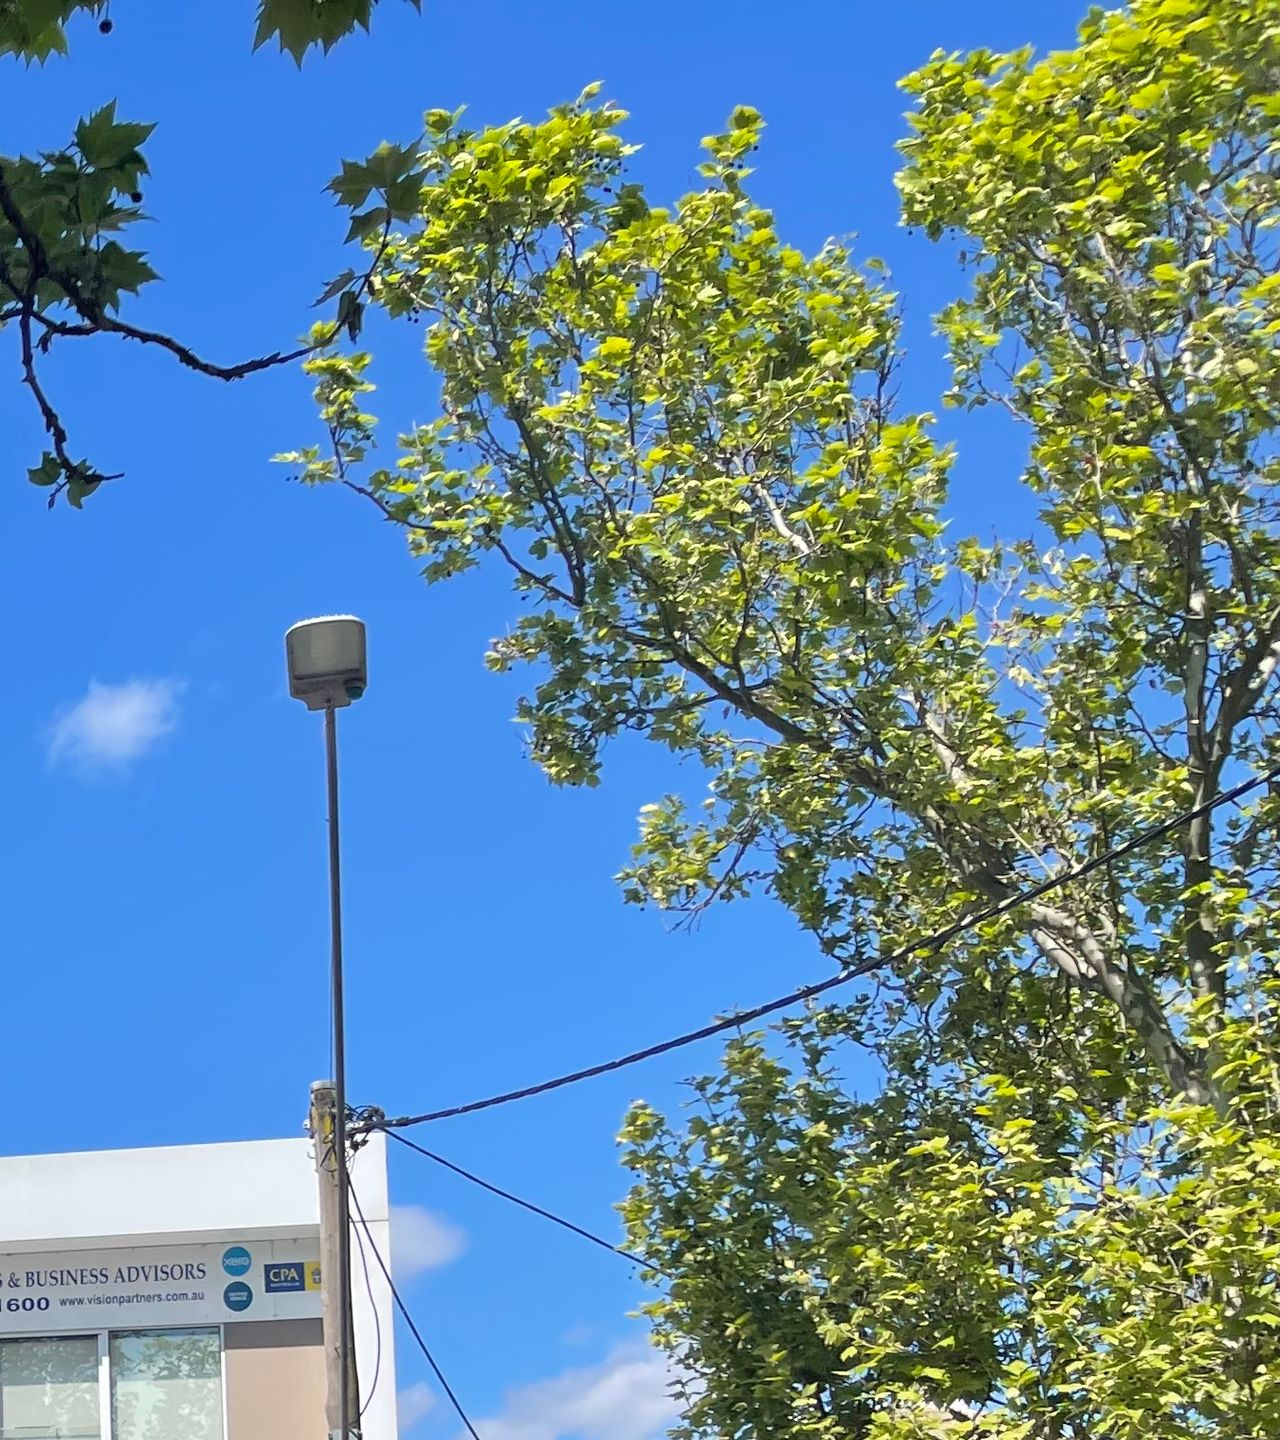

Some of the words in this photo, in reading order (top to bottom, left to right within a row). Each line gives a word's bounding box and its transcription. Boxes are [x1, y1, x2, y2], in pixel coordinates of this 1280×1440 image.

[7, 1272, 21, 1289] &
[25, 1266, 109, 1288] BUSINESS
[113, 1262, 207, 1284] ADVISORS
[269, 1268, 299, 1282] CPA
[59, 1291, 205, 1307] www.visionpartners.com.au
